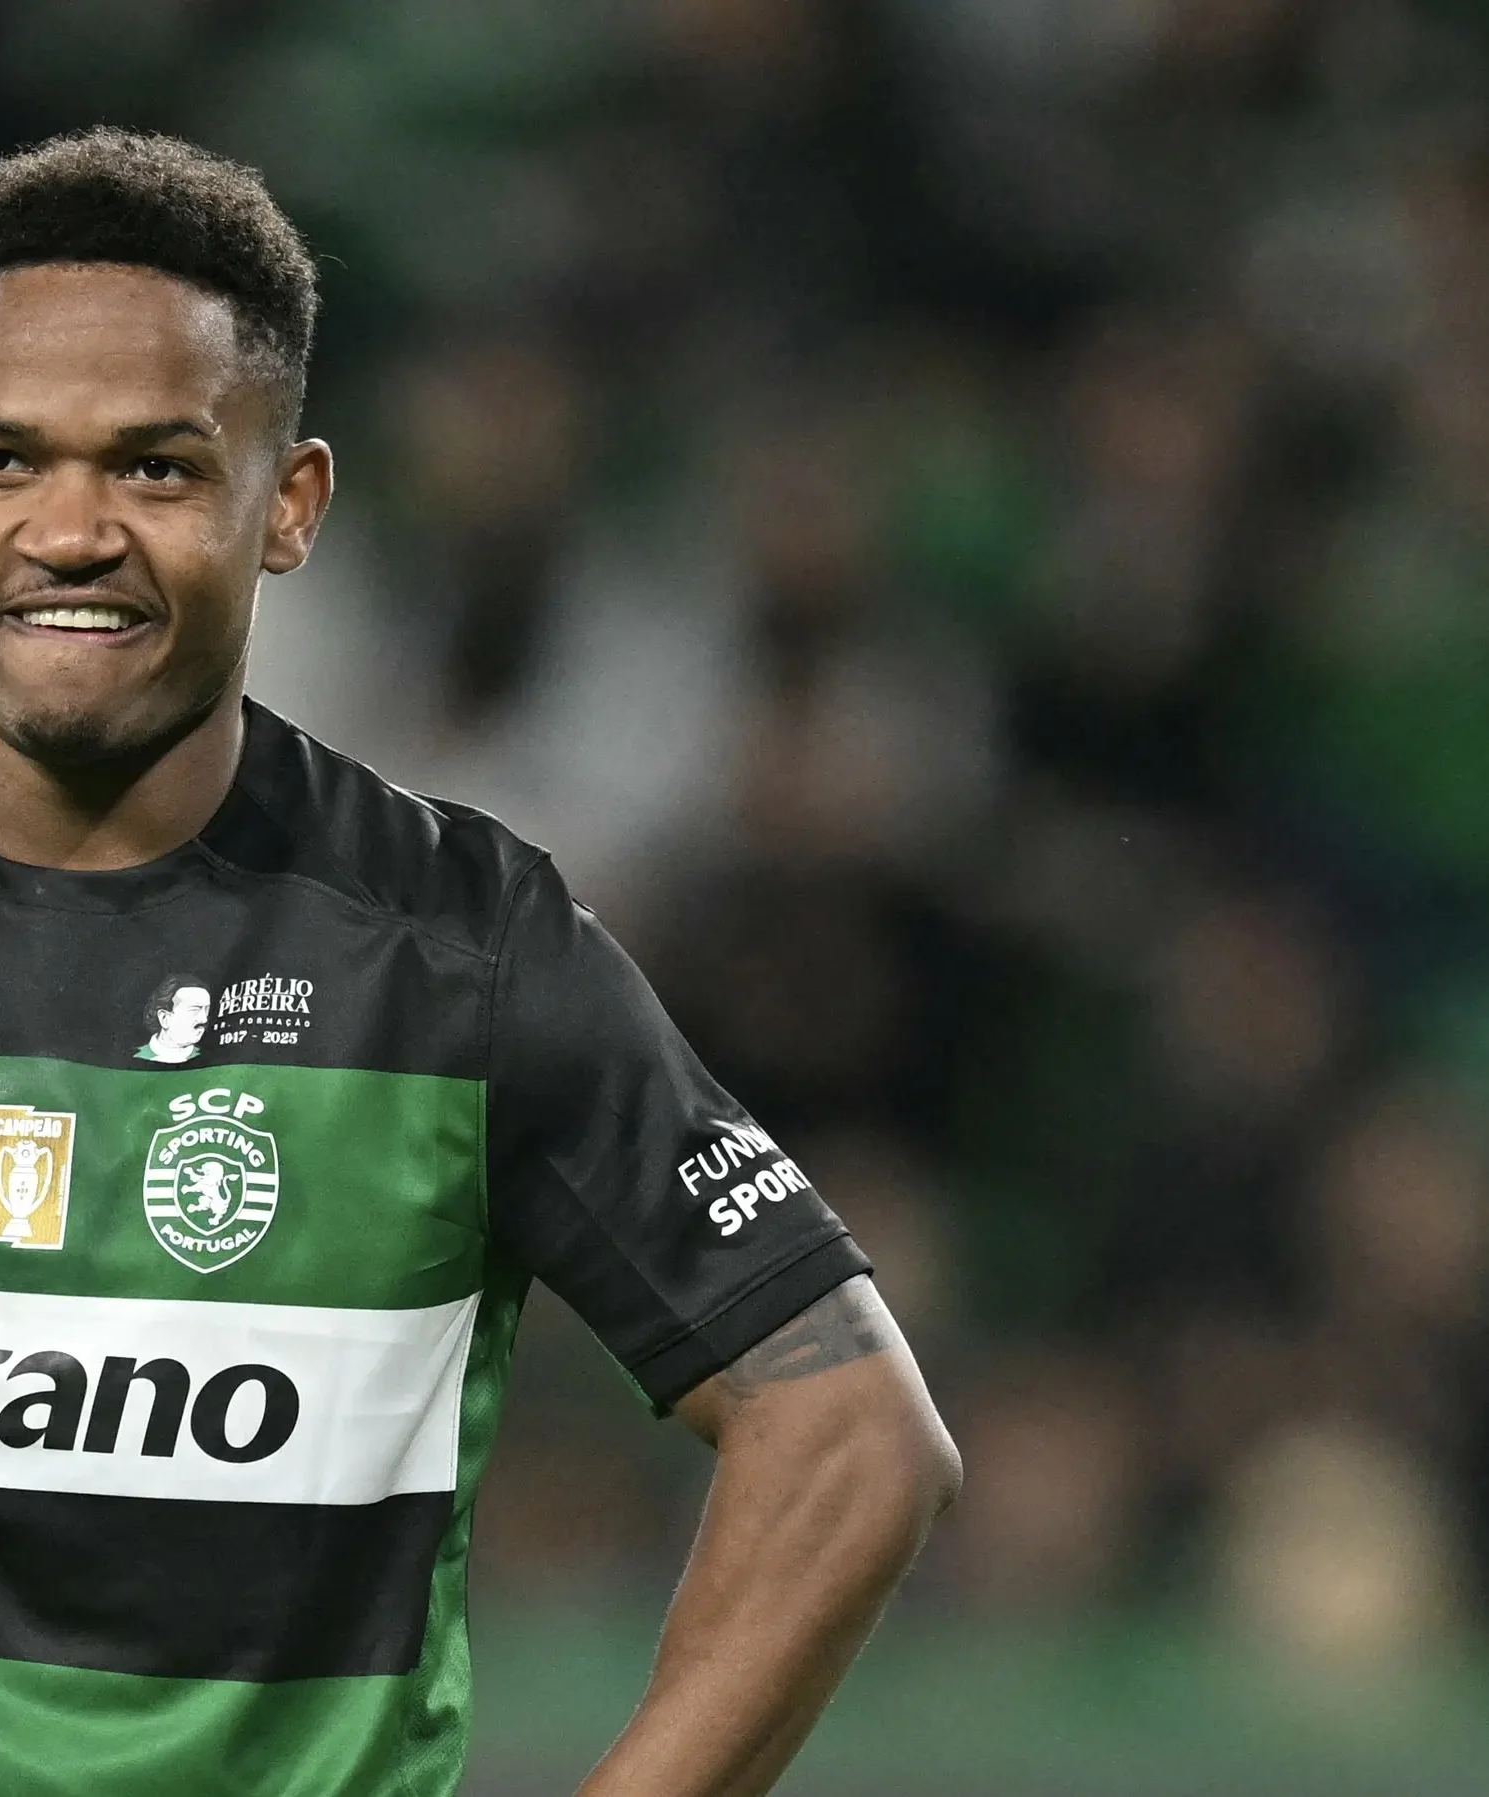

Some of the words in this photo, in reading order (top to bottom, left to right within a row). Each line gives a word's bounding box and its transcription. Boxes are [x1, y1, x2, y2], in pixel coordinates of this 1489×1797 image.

[219, 972, 313, 1003] AURÉLIO
[218, 993, 310, 1017] PEREIRA
[239, 1017, 311, 1028] FORMAÇÃO
[262, 1031, 298, 1044] 2025
[169, 1088, 265, 1121] SCP
[159, 1127, 266, 1168] SPORTING
[160, 1223, 258, 1252] PORTUGAL
